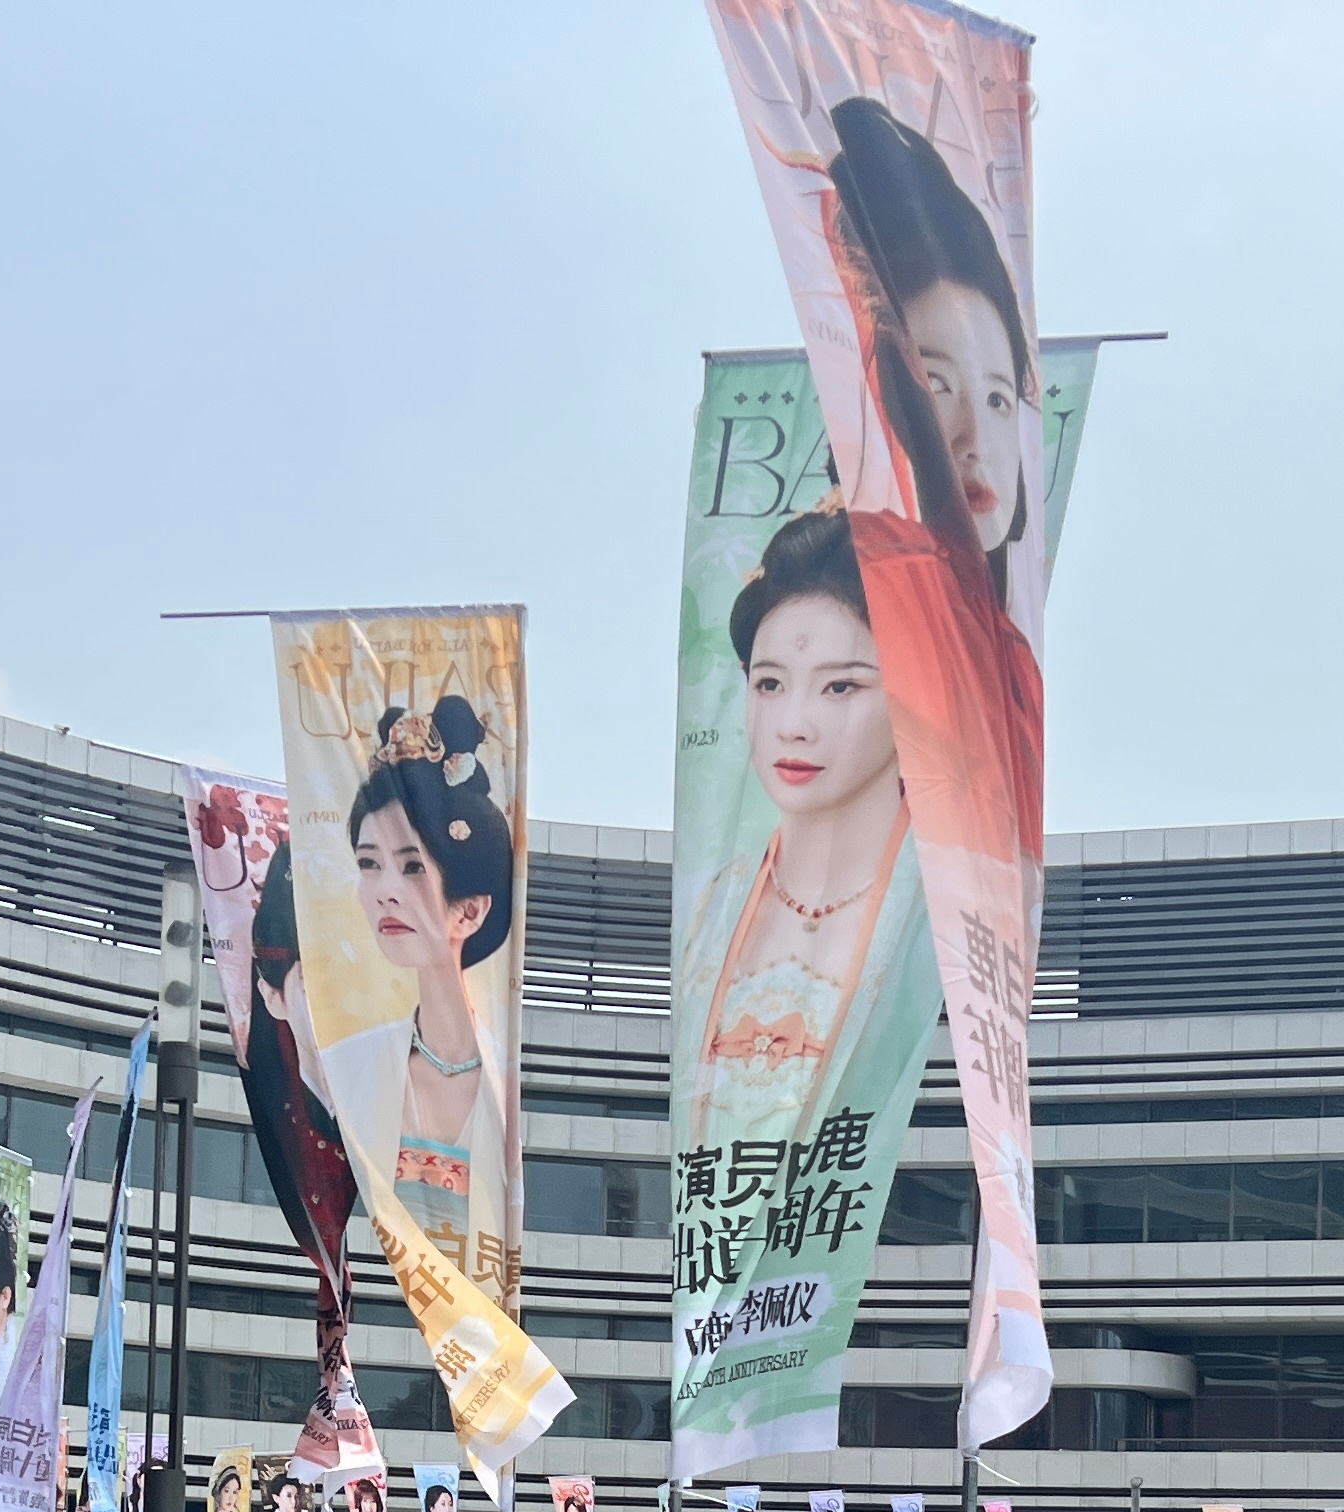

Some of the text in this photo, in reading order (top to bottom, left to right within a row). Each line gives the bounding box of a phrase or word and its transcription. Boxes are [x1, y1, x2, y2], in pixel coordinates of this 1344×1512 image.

[676, 1106, 875, 1214] 演员鹿
[728, 1349, 809, 1382] ANNIVERSARY
